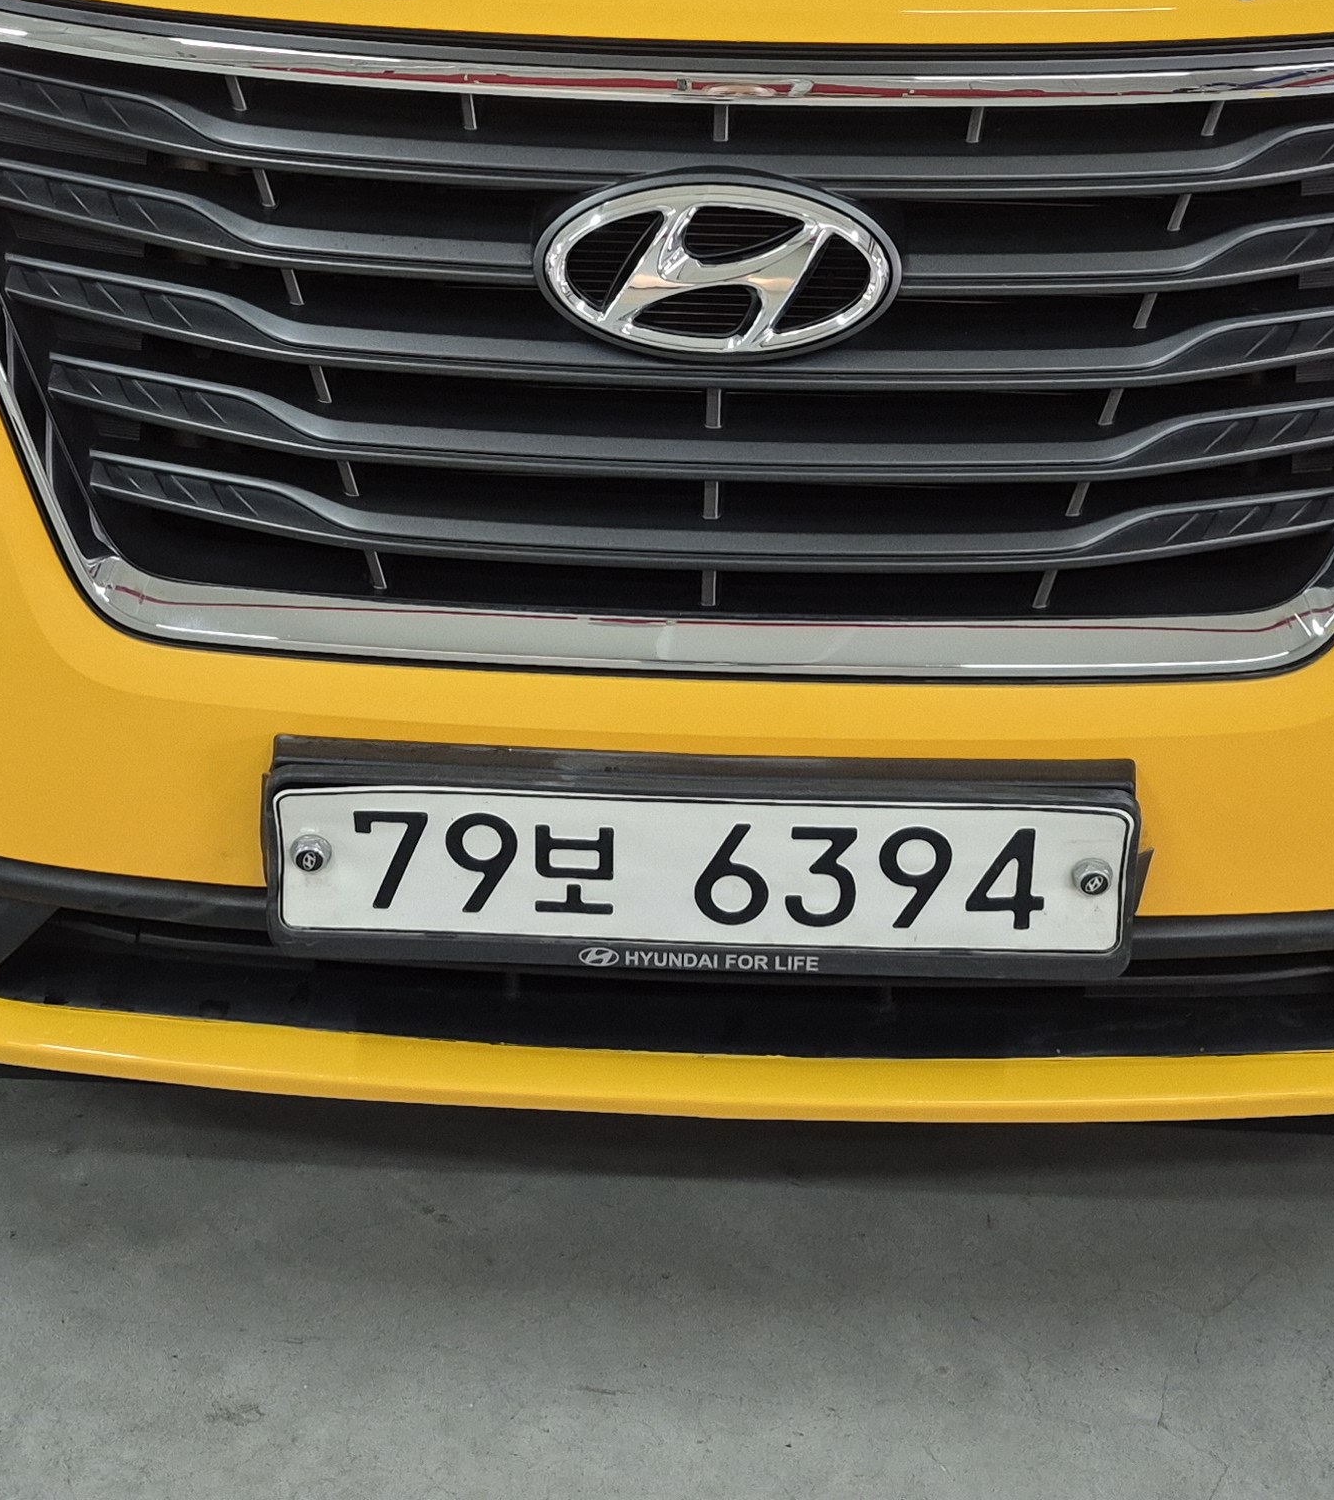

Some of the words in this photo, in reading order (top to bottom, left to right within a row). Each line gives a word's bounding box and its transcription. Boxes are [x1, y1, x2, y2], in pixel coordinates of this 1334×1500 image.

[353, 810, 615, 915] 79보
[694, 822, 1045, 930] 6394
[624, 950, 718, 969] HYUNDAI
[724, 954, 769, 971] FOR
[774, 955, 820, 972] LIFE
